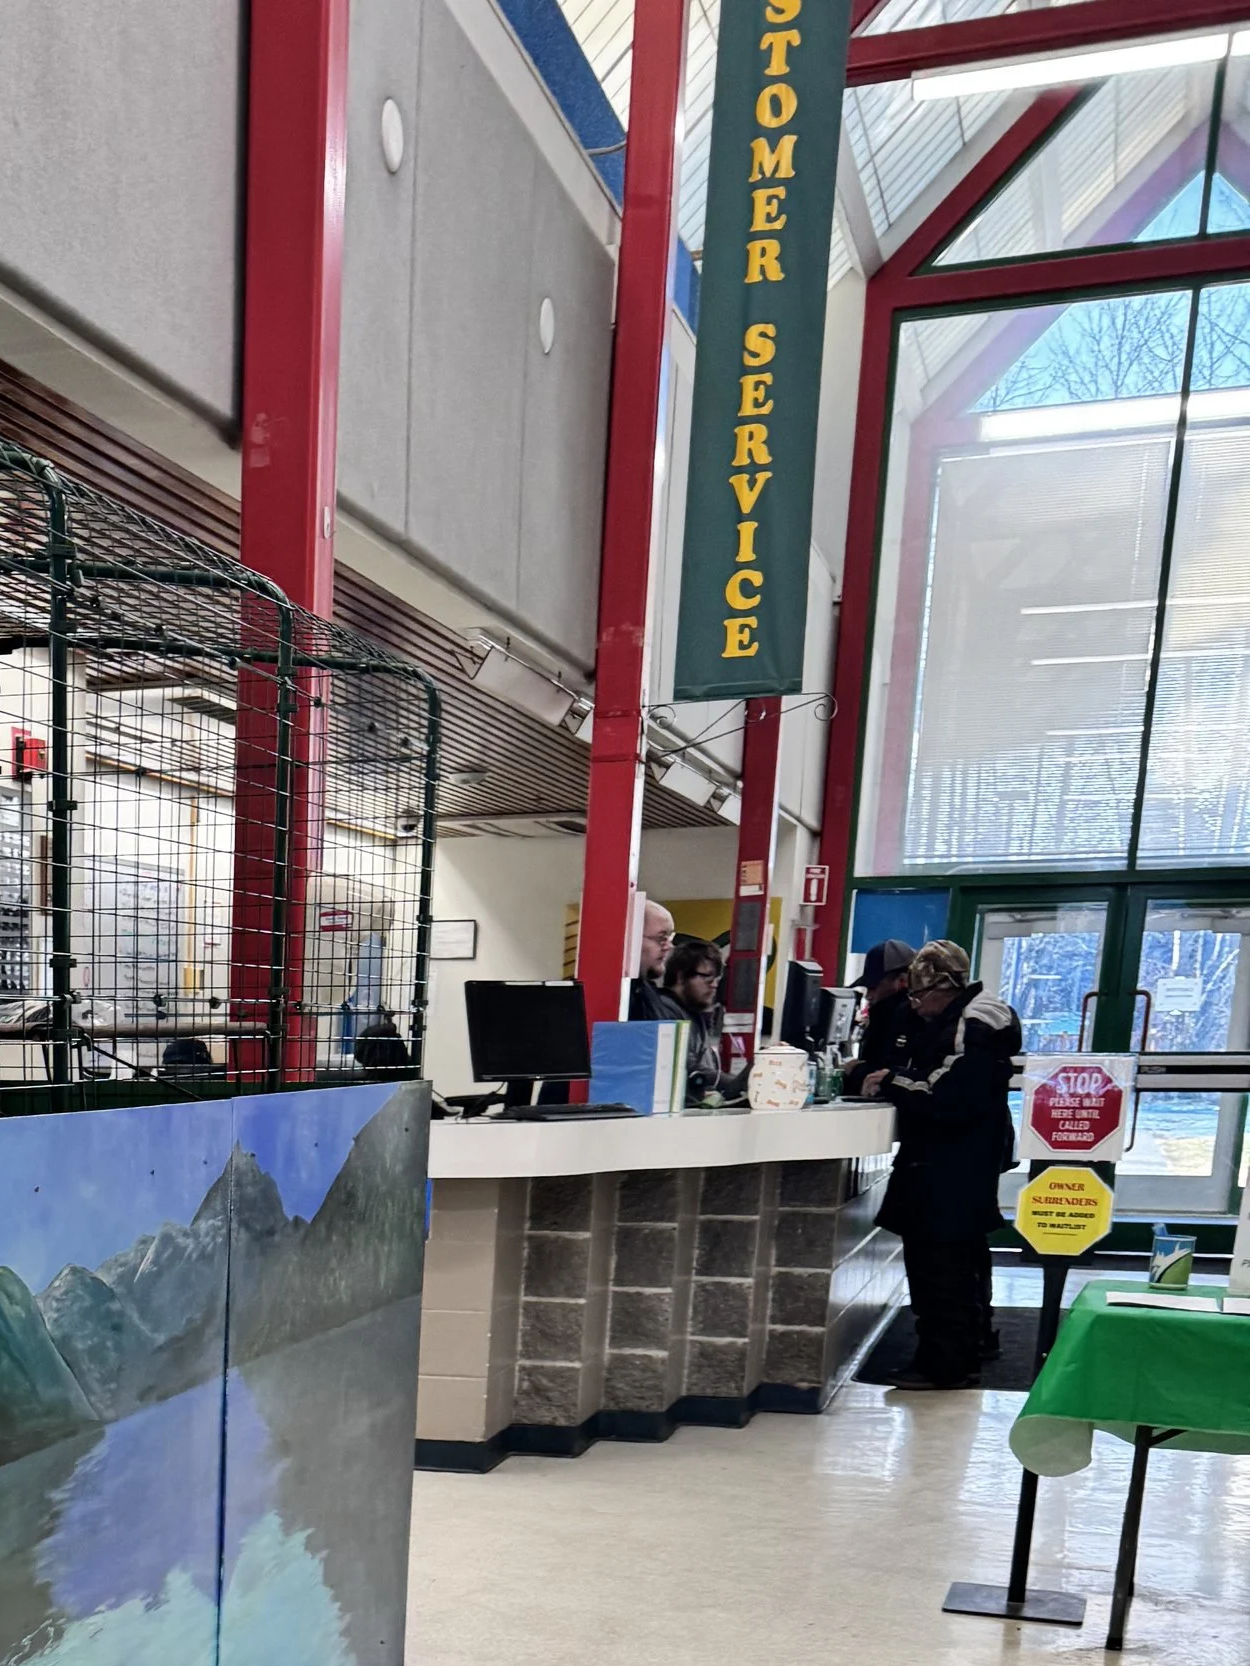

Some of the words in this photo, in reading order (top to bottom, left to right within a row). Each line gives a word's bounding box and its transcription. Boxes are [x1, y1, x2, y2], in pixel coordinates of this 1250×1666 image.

[721, 322, 777, 658] SERVICE
[1056, 1072, 1103, 1095] STOP
[1049, 1097, 1081, 1108] PLEASE
[1082, 1097, 1105, 1108] WAIT
[1051, 1108, 1074, 1119] HERE
[1075, 1108, 1100, 1119] UNTIL
[1058, 1120, 1090, 1130] CALLED
[1051, 1131, 1095, 1142] FORWARD
[1048, 1181, 1086, 1192] OWNER
[1031, 1195, 1099, 1207] SURRENDERS
[1049, 1222, 1087, 1230] WAITLIST
